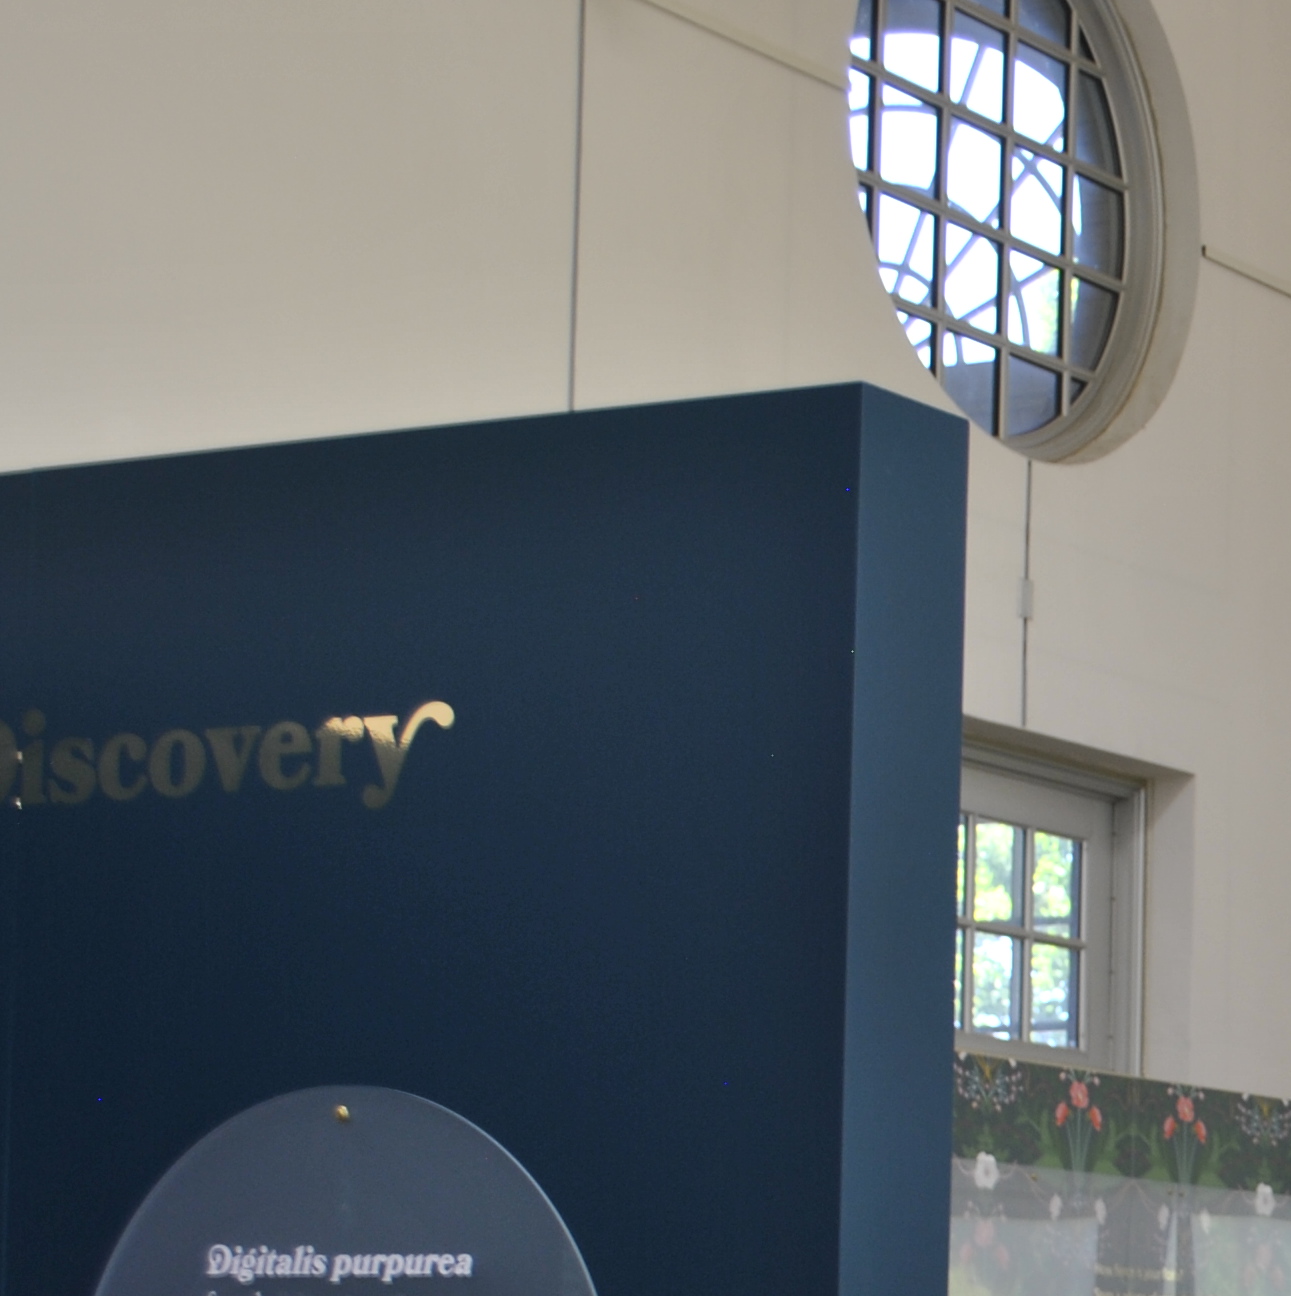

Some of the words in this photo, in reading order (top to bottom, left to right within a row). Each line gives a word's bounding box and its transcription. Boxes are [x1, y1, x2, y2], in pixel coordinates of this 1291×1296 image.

[0, 700, 455, 810] iscovery
[205, 1243, 327, 1284] Digitalis
[329, 1252, 474, 1284] purpurea
